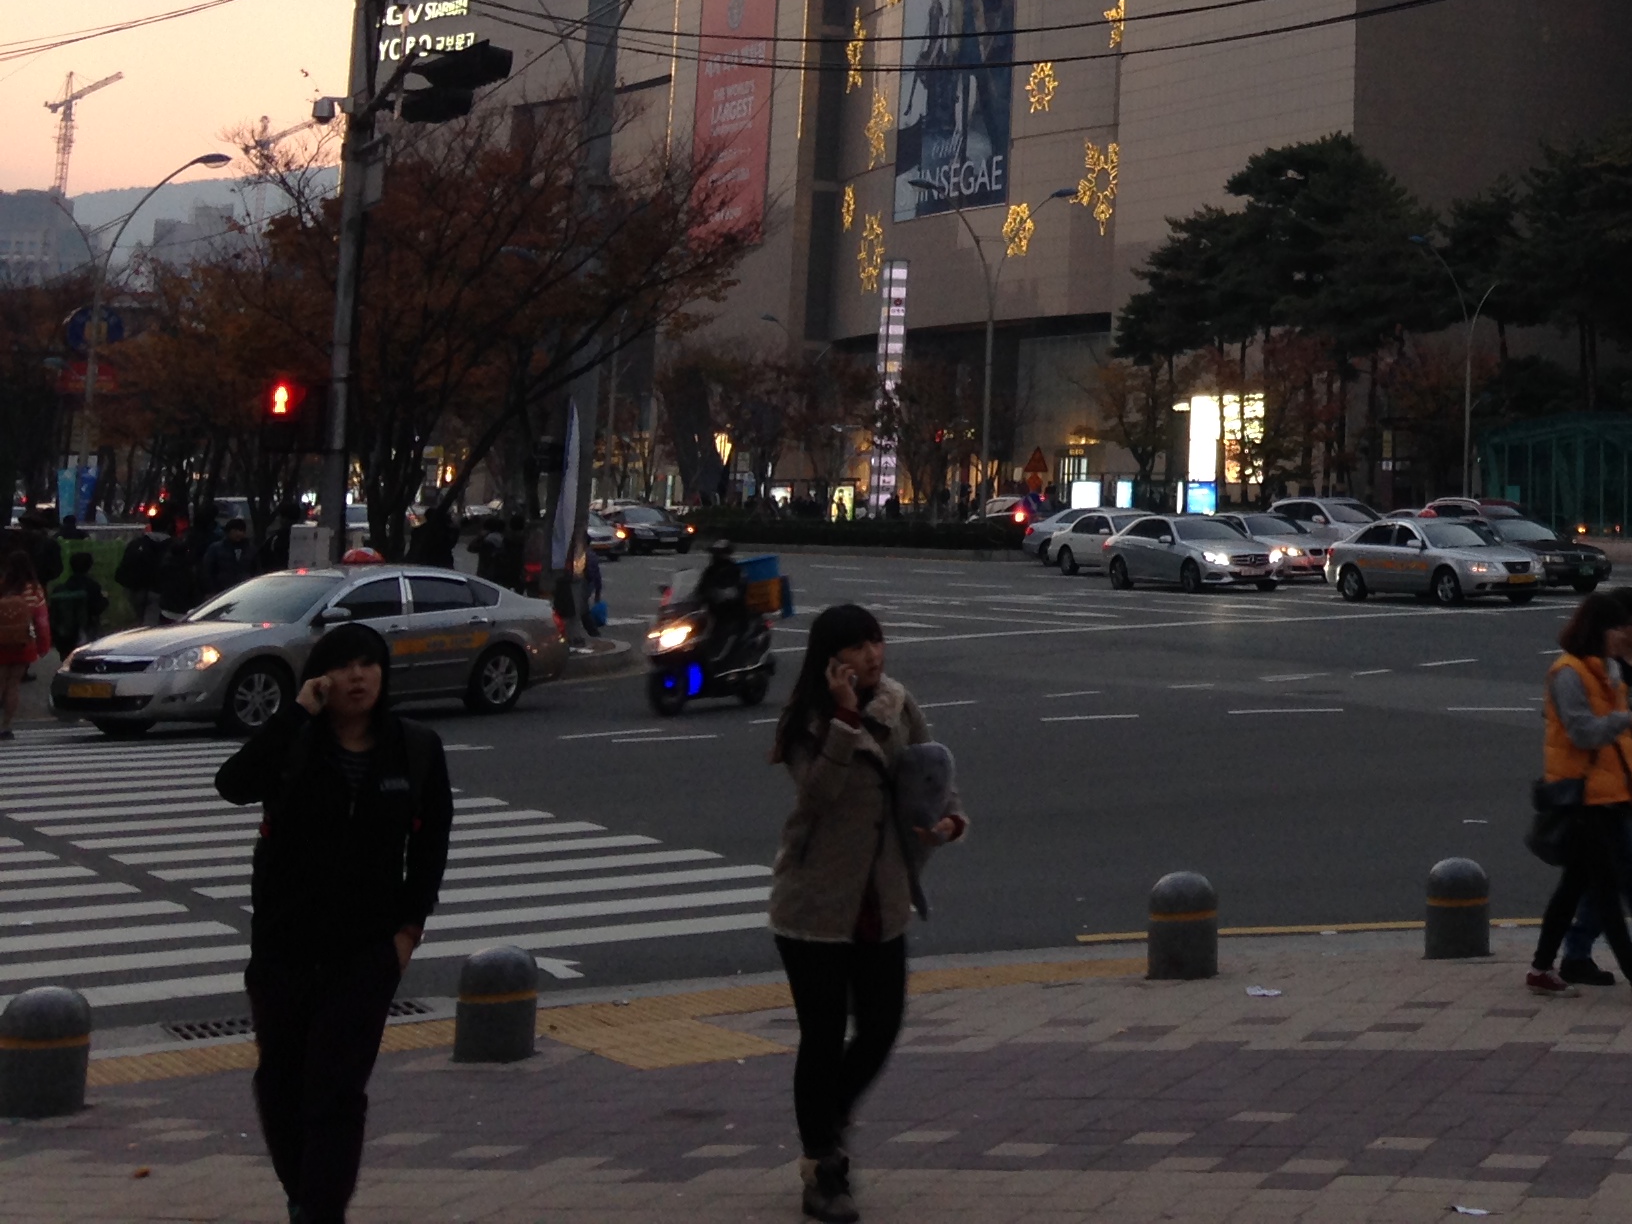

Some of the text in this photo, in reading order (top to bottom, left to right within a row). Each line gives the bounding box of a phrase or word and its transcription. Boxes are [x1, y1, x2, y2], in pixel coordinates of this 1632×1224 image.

[376, 3, 423, 27] GV
[379, 34, 432, 62] YOBO
[711, 97, 754, 127] LARGEST
[916, 155, 1003, 202] INSEGAE
